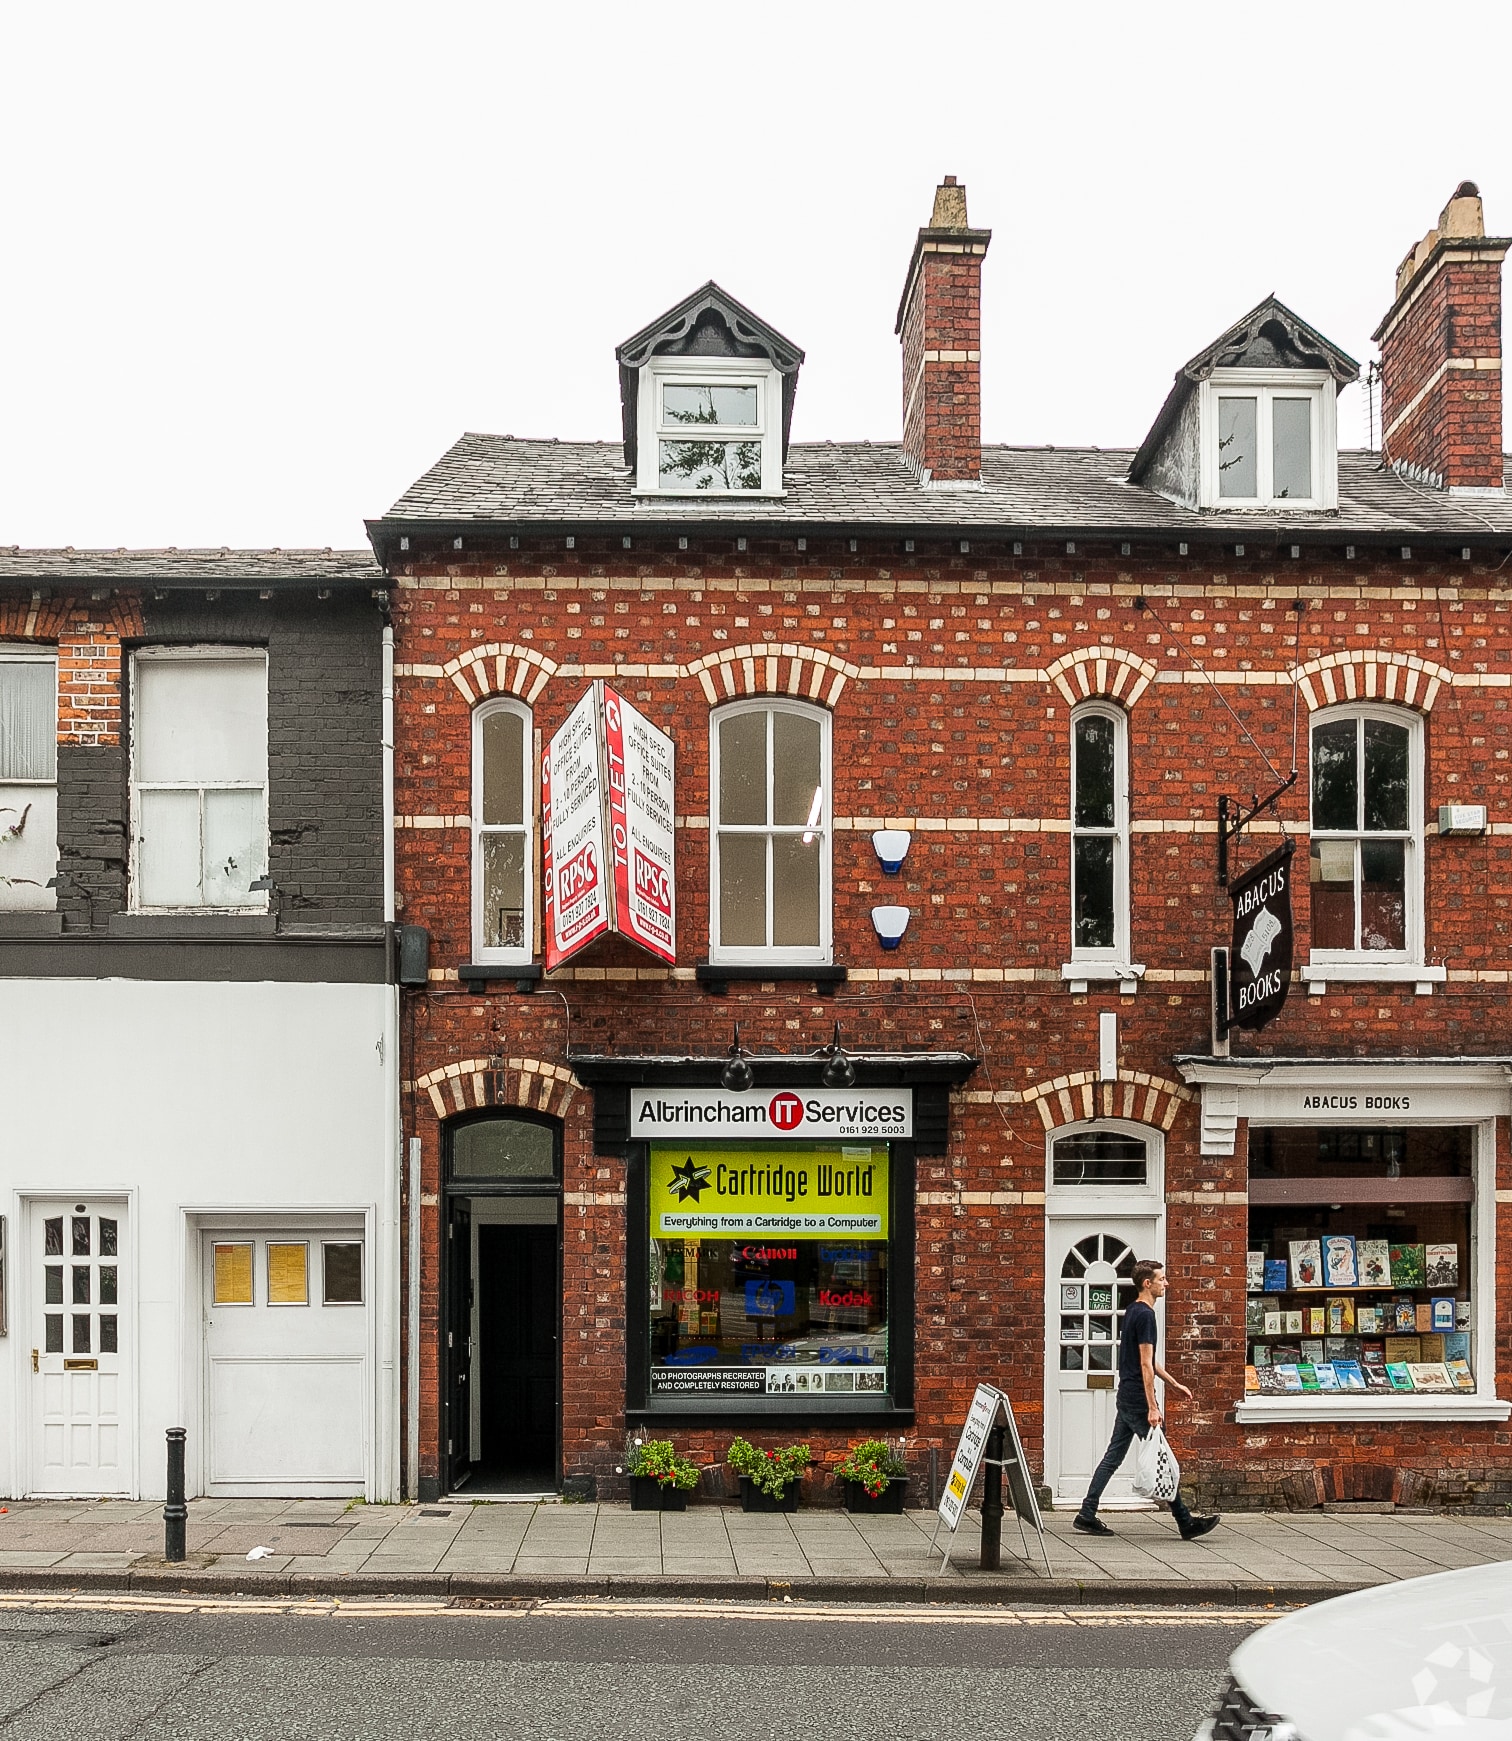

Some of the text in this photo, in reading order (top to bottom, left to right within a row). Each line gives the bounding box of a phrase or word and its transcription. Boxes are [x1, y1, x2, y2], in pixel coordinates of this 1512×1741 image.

[553, 723, 592, 776] OFFICE SUITES
[559, 711, 586, 753] HIGH SPEC
[633, 722, 666, 760] HIGH SPEC
[565, 756, 581, 782] FROM
[628, 735, 672, 782] OFFICE SUITES
[642, 764, 659, 788] FROM
[570, 761, 593, 796] PERSON
[552, 777, 598, 832] FULLY SERVICED
[609, 744, 627, 867] TO LET
[627, 787, 673, 835] FULLY SERVICED
[647, 785, 671, 814] PERSON
[556, 816, 597, 863] ALL ENQUIRIES
[631, 825, 672, 866] ALL ENQUIRIES
[545, 867, 553, 913] TO
[1236, 867, 1285, 920] ABACUS
[1239, 968, 1281, 1010] BOOKS
[638, 1100, 906, 1123] Altrincham IT Services
[1303, 1096, 1410, 1109] ABACUS BOOKS
[839, 1126, 905, 1134] 0161 929 5003
[716, 1163, 873, 1202] Cartridge World
[664, 1216, 878, 1230] Everything from a Cartridge to a Computer
[742, 1245, 797, 1260] Canon
[663, 1288, 719, 1302] RICOH
[819, 1289, 874, 1307] Kodak
[652, 1372, 766, 1380] OLD PHOTOGRAPHS RECREATED
[657, 1381, 760, 1389] AND COMPLETELY RESTORED
